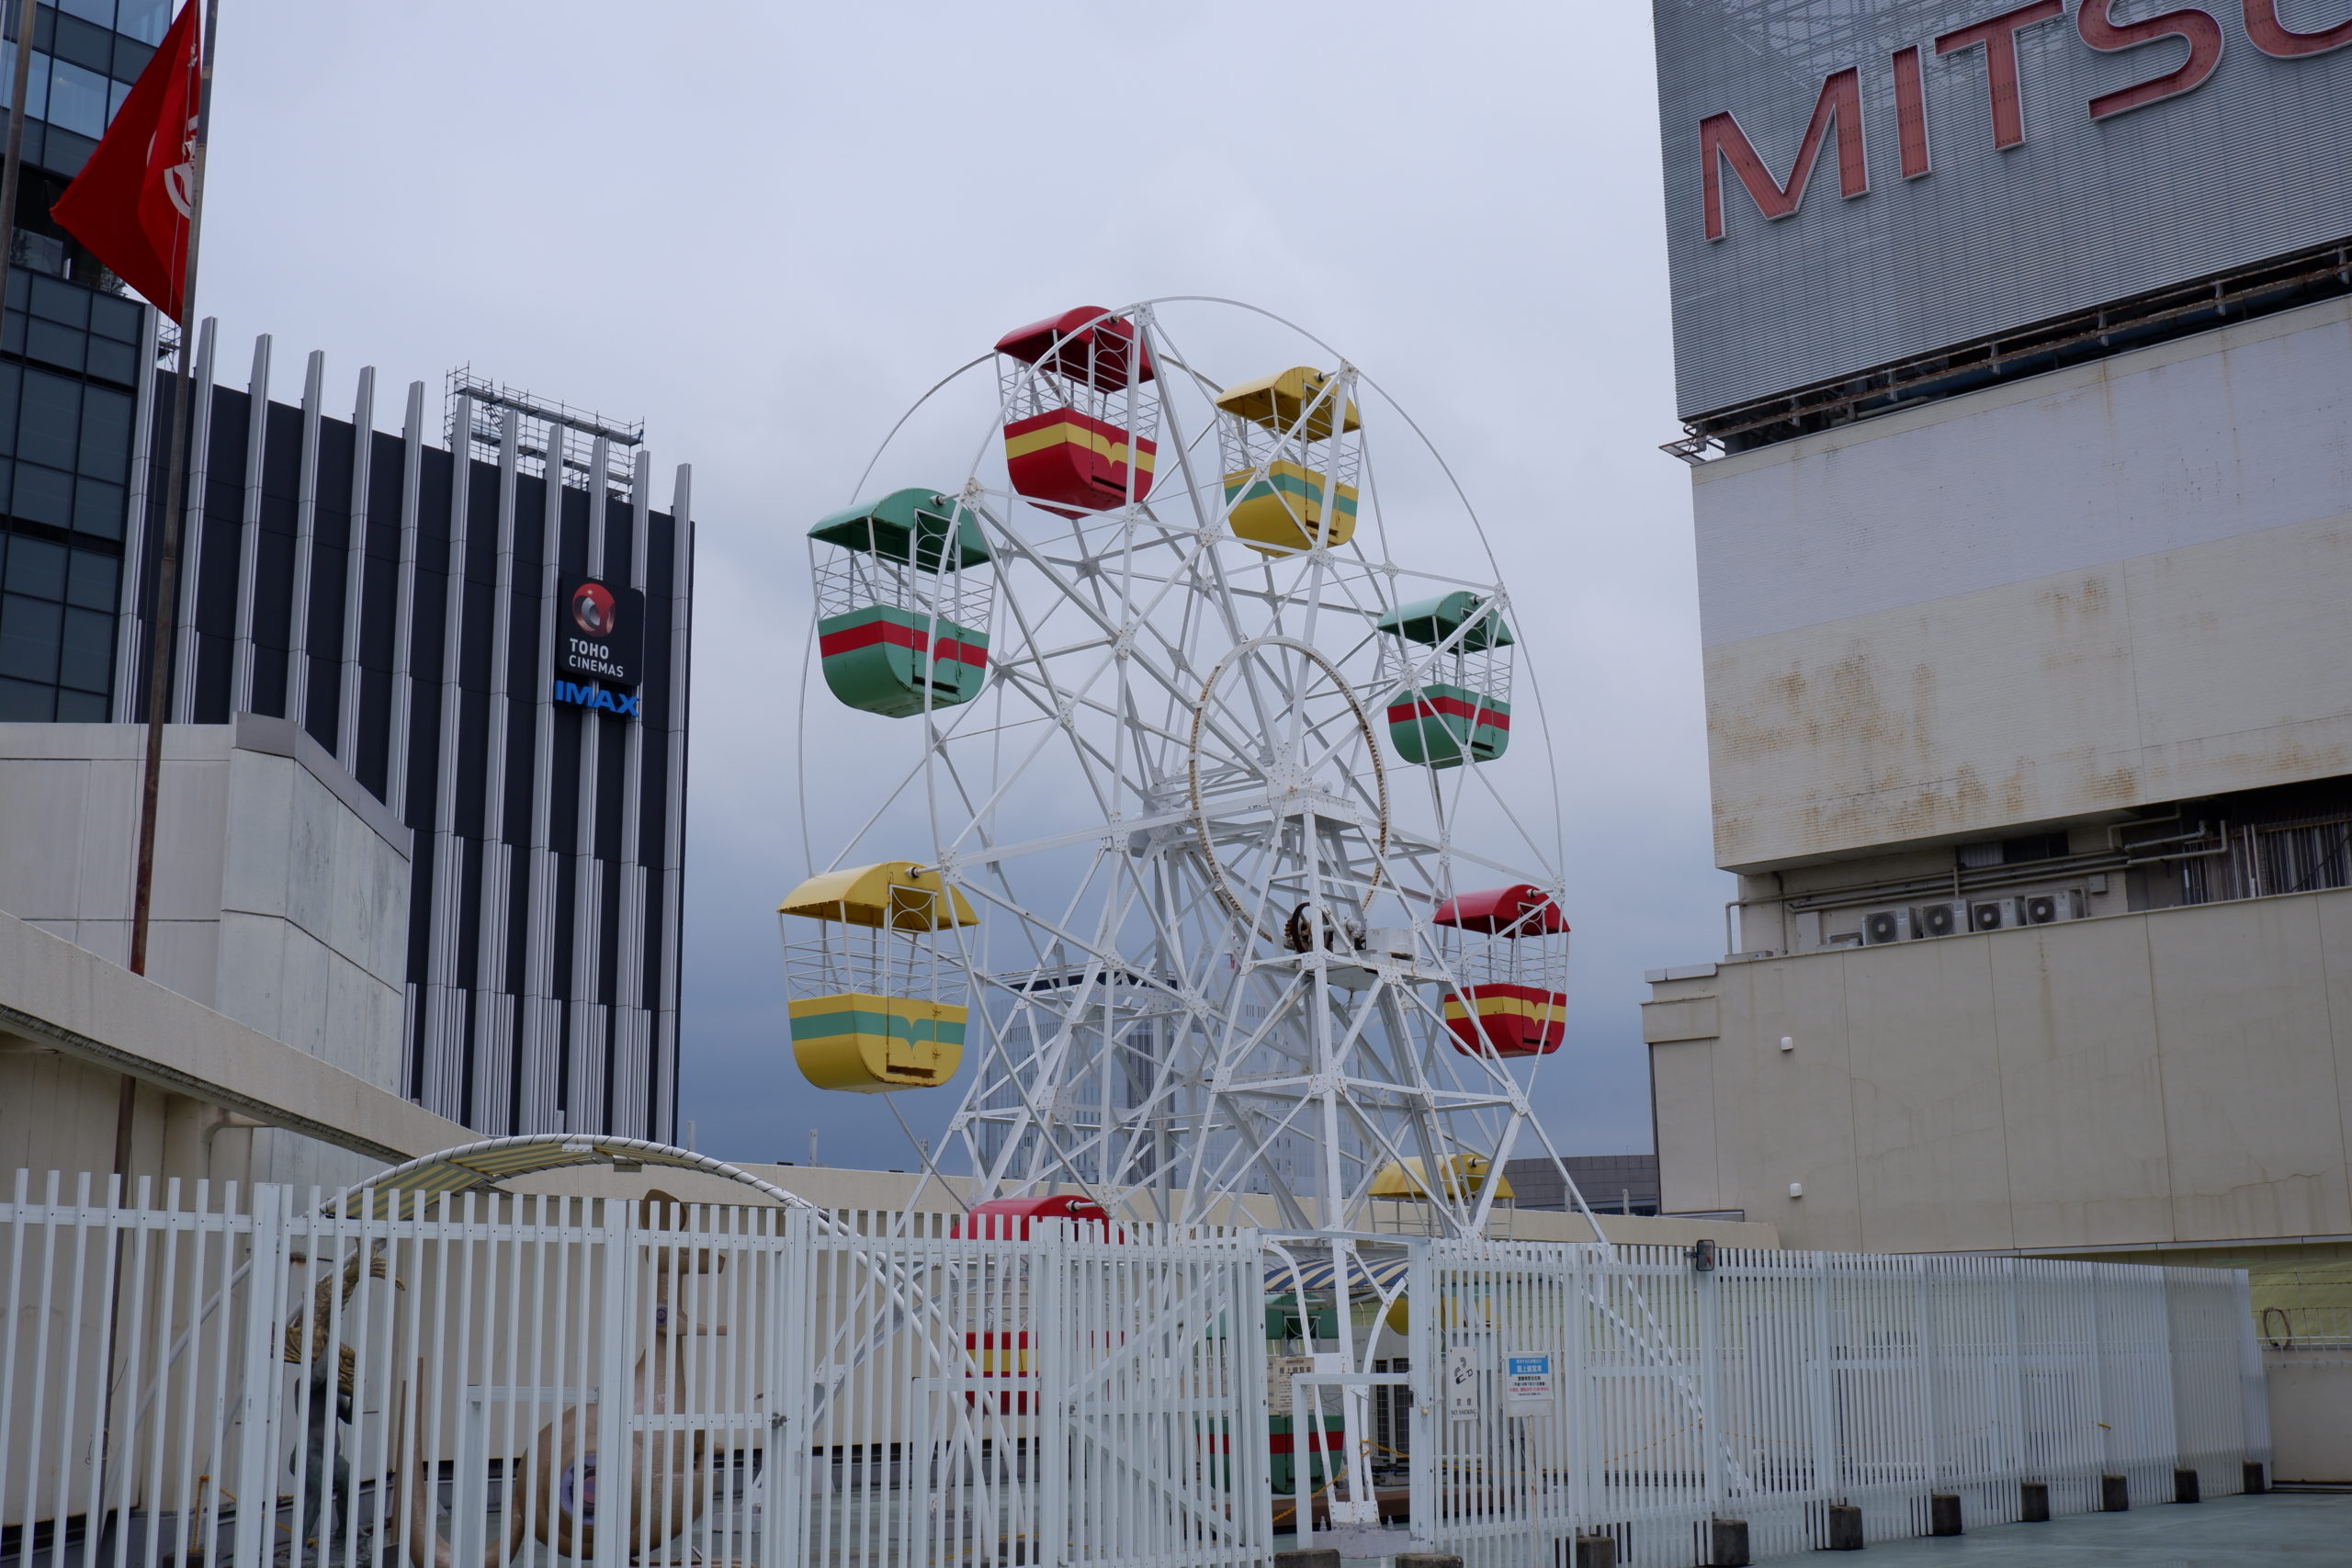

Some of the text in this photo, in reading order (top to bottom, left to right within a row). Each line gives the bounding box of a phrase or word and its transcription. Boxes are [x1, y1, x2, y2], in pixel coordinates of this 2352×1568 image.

[570, 637, 609, 660] TOHO
[569, 655, 624, 677] CINEMAS
[555, 680, 640, 717] IMAX
